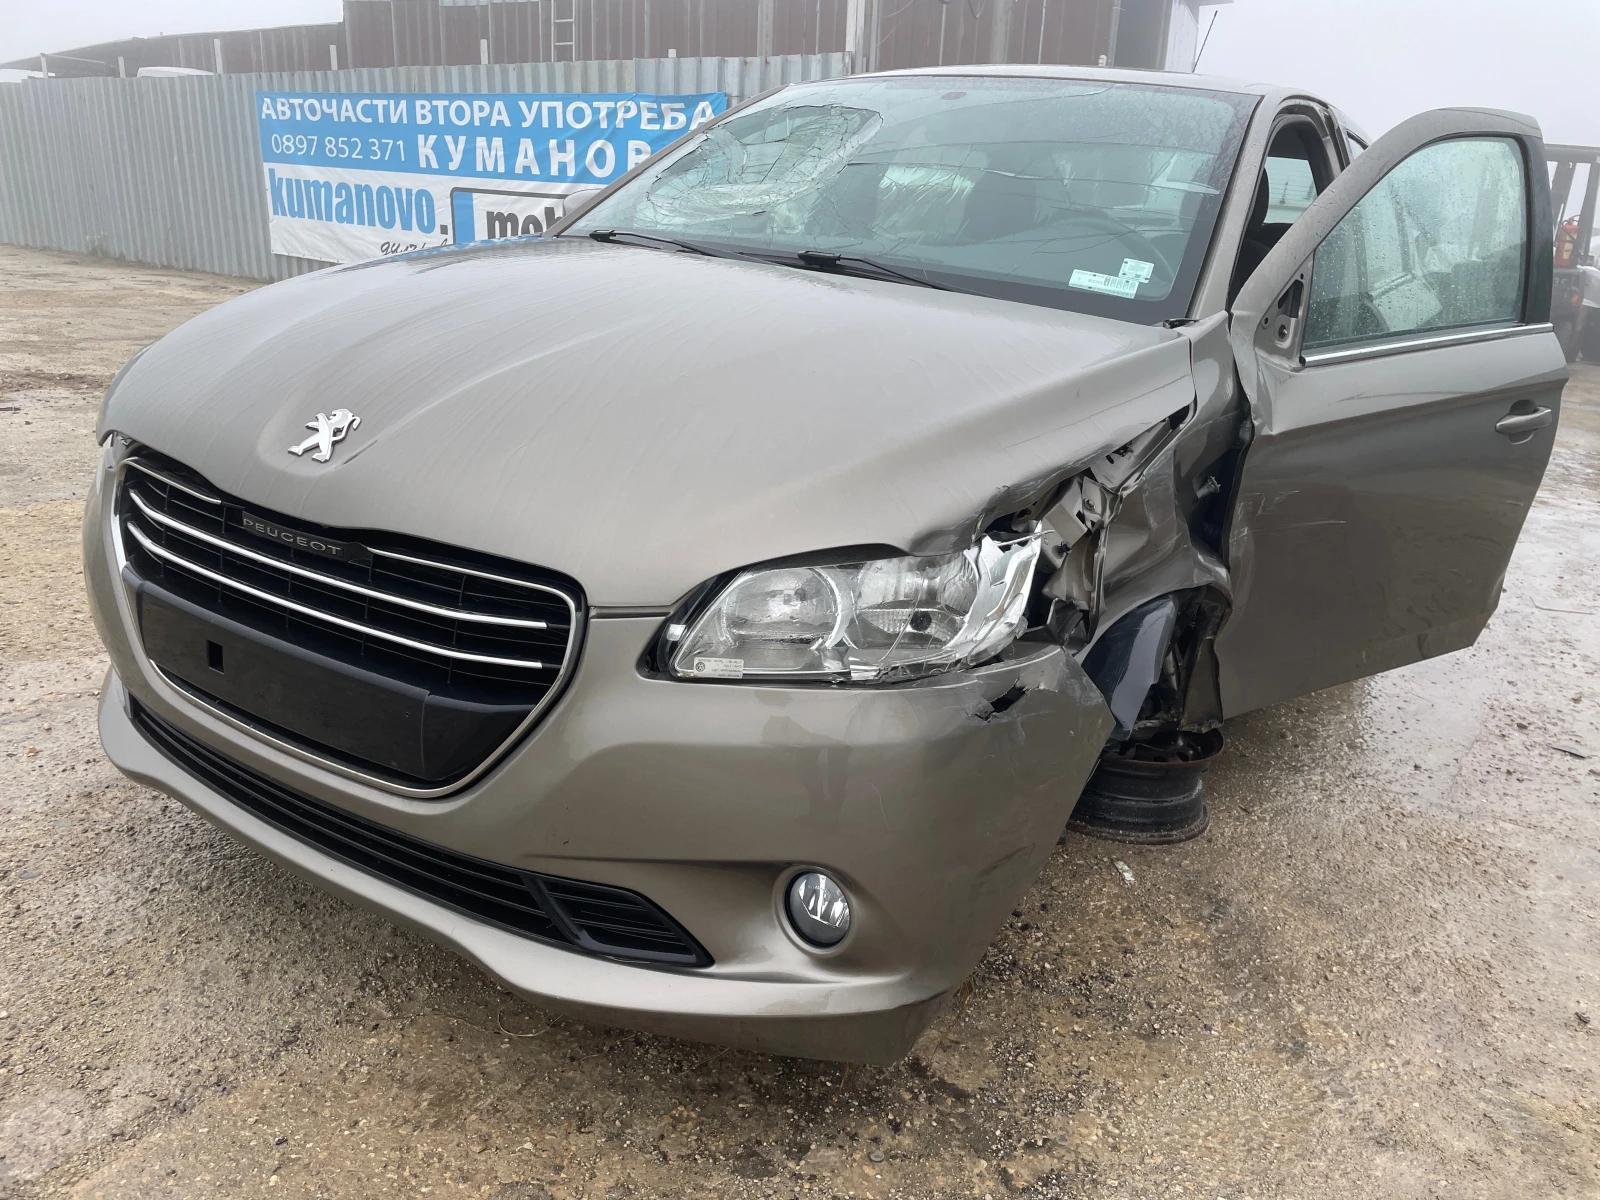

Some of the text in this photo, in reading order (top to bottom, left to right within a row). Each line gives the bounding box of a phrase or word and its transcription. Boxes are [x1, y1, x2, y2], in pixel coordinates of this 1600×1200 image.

[261, 97, 716, 132] АВТОЧАСТИ ВТОРА УПОТРЕБА
[271, 133, 405, 162] 0897 852 371
[243, 518, 341, 555] PEUGEOT
